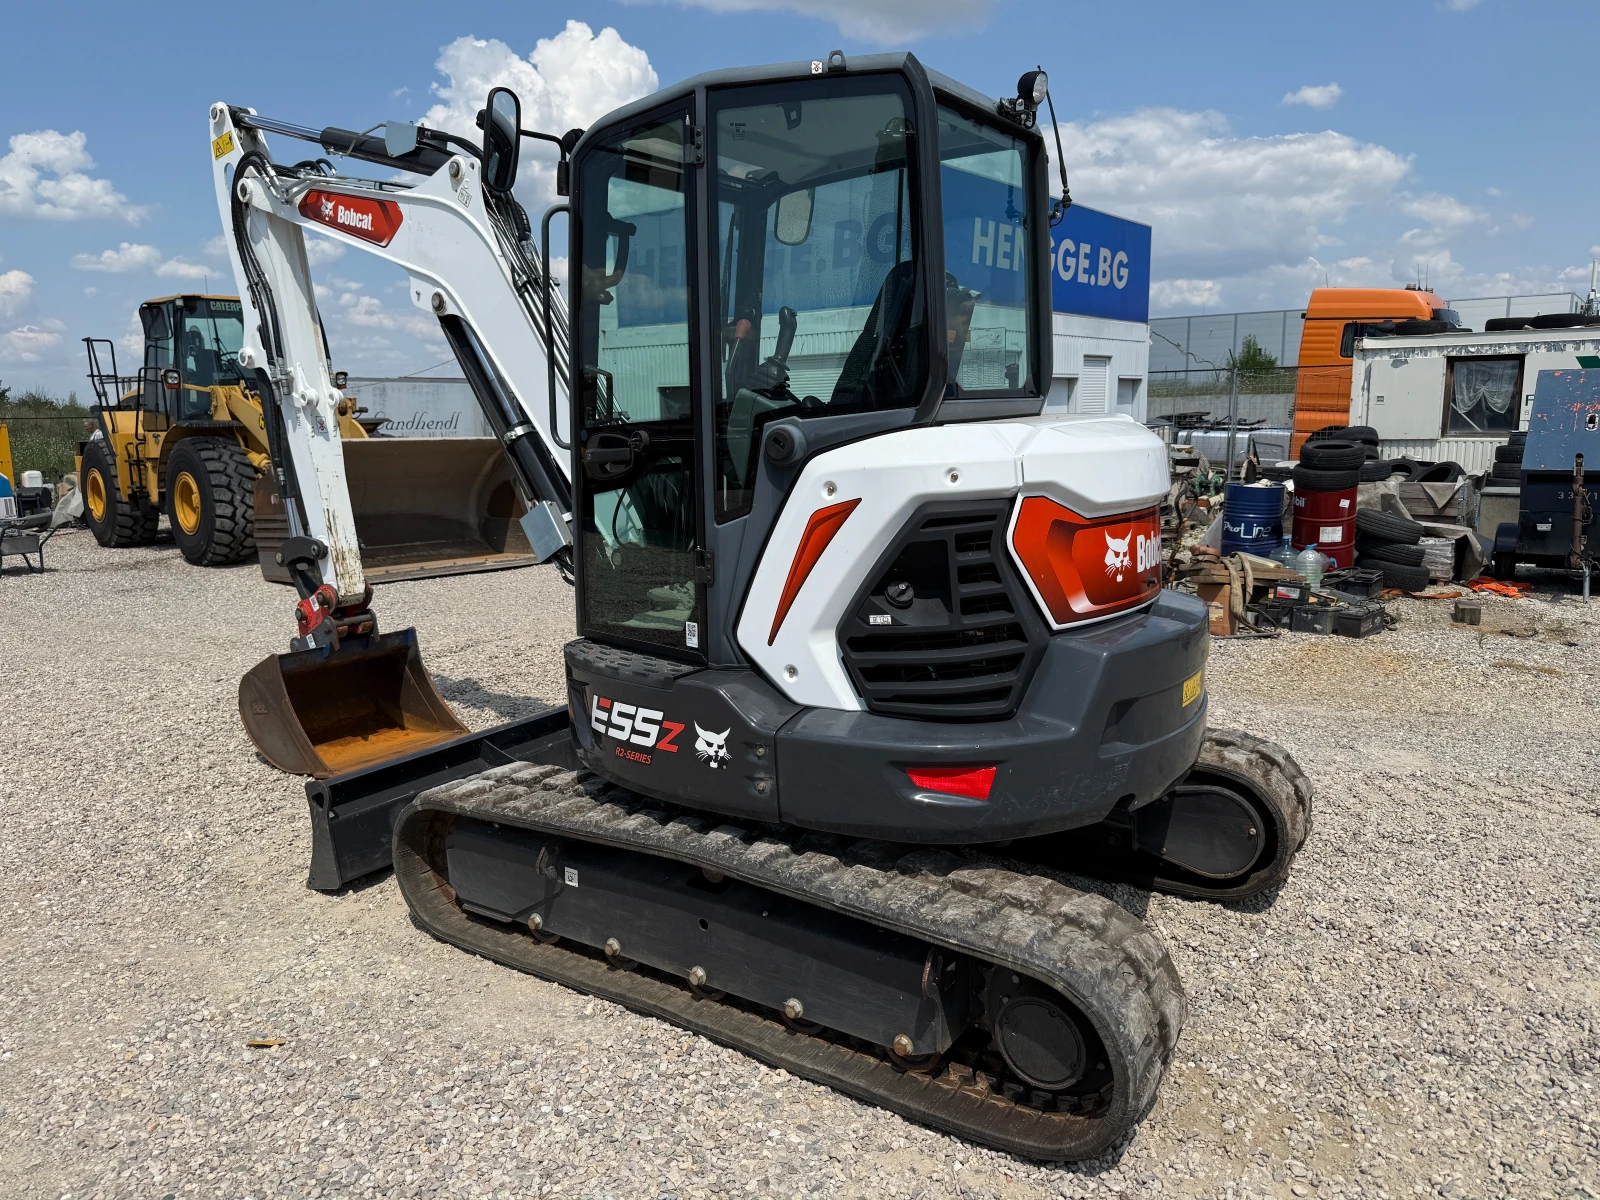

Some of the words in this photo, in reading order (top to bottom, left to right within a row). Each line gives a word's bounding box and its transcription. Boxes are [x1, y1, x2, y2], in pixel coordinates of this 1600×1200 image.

[337, 205, 374, 231] Bobcat
[972, 217, 1129, 290] HENGE.BG
[210, 301, 242, 311] CATERP
[1294, 495, 1306, 508] bil
[615, 746, 652, 765] R2-SERIES
